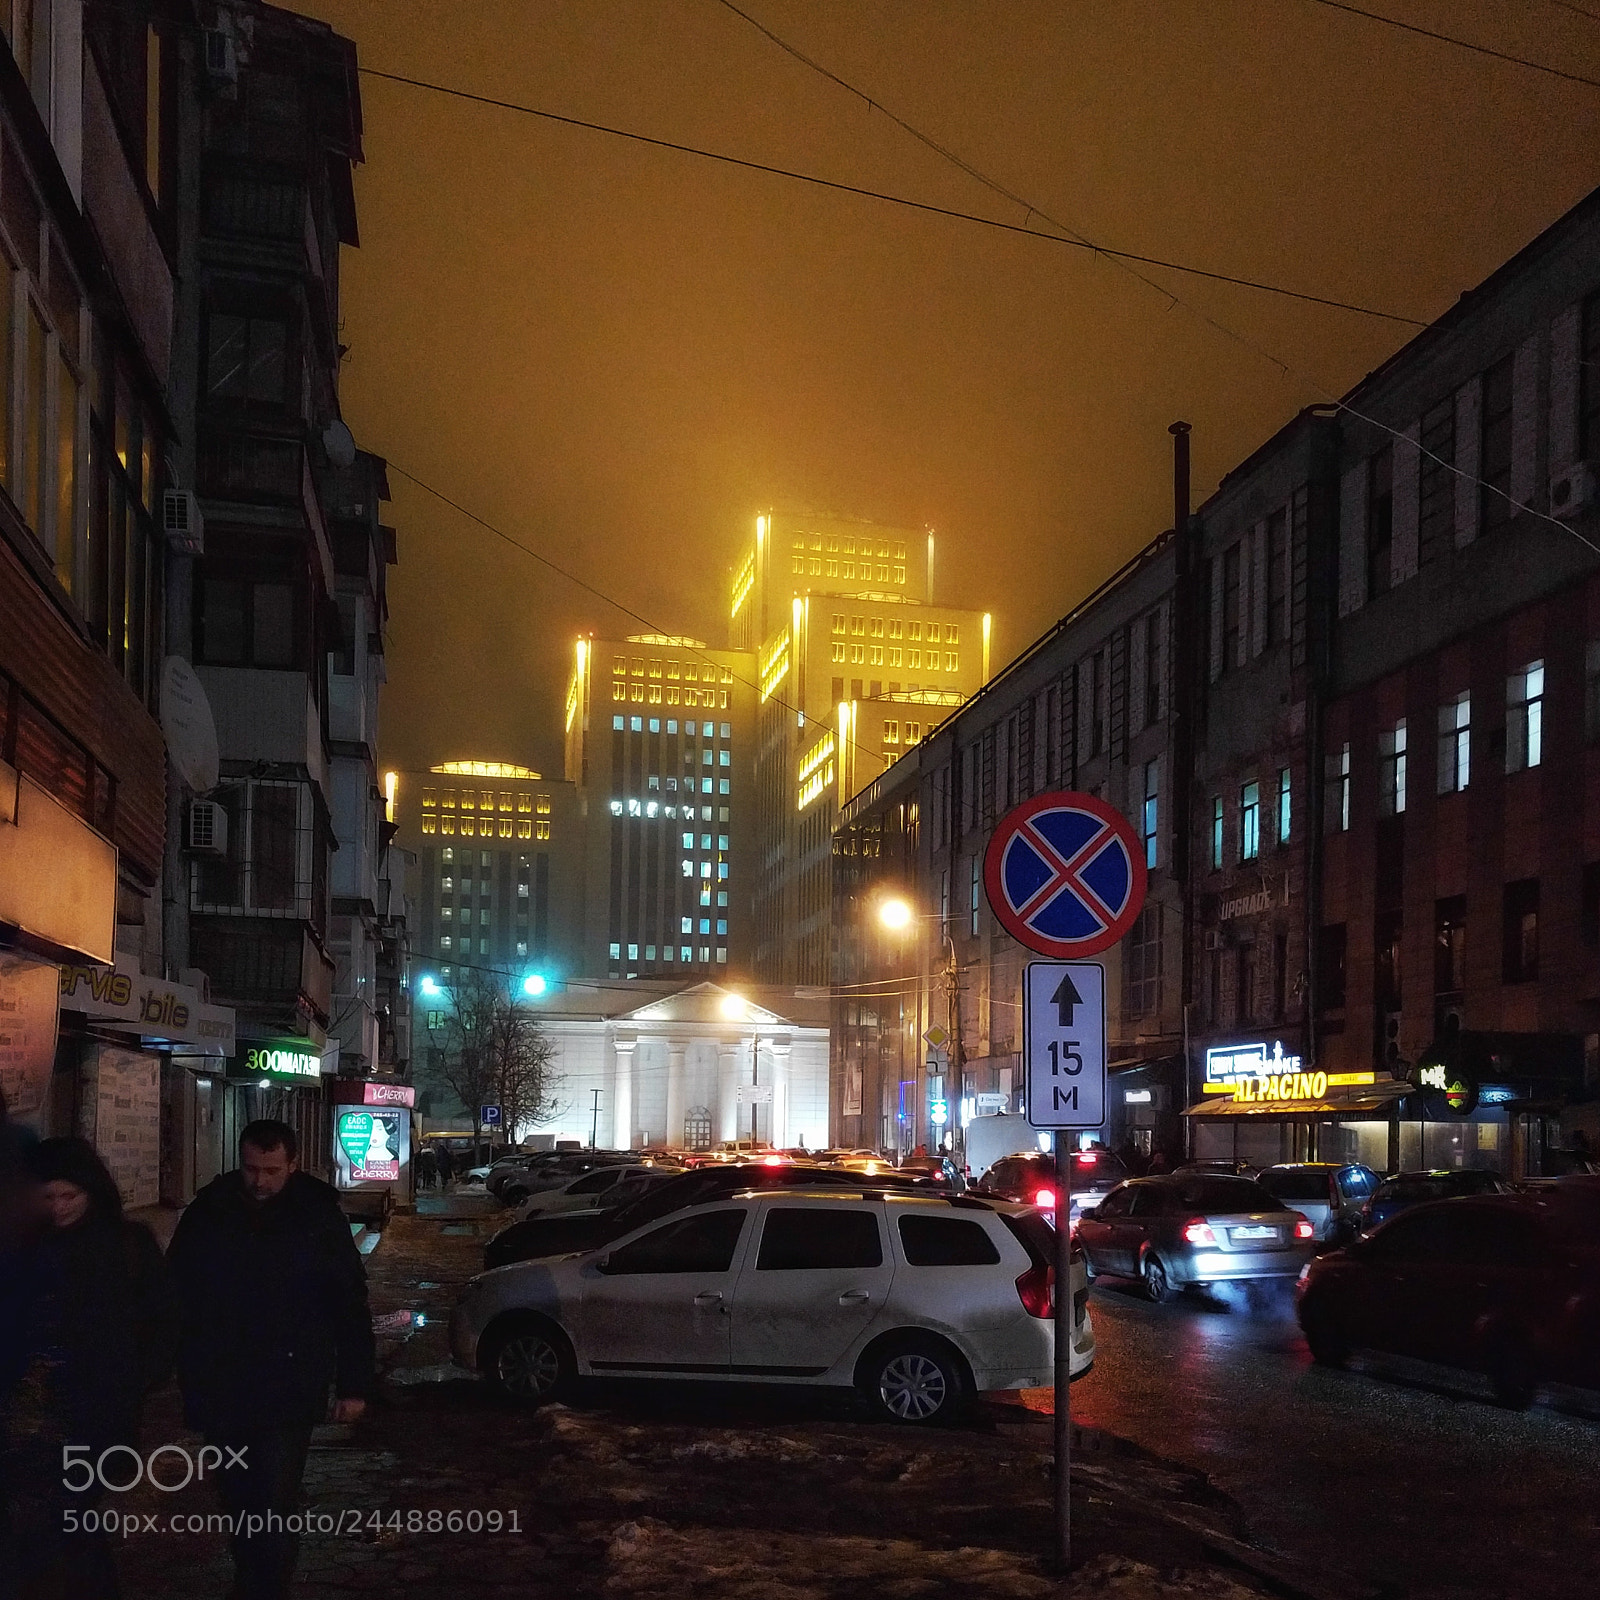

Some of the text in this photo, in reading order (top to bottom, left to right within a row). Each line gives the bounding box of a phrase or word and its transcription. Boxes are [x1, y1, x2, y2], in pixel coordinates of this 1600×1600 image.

[1048, 1040, 1083, 1076] 15
[1232, 1071, 1328, 1103] AL PACINO
[487, 1107, 499, 1123] P
[353, 1169, 398, 1180] CHERRY
